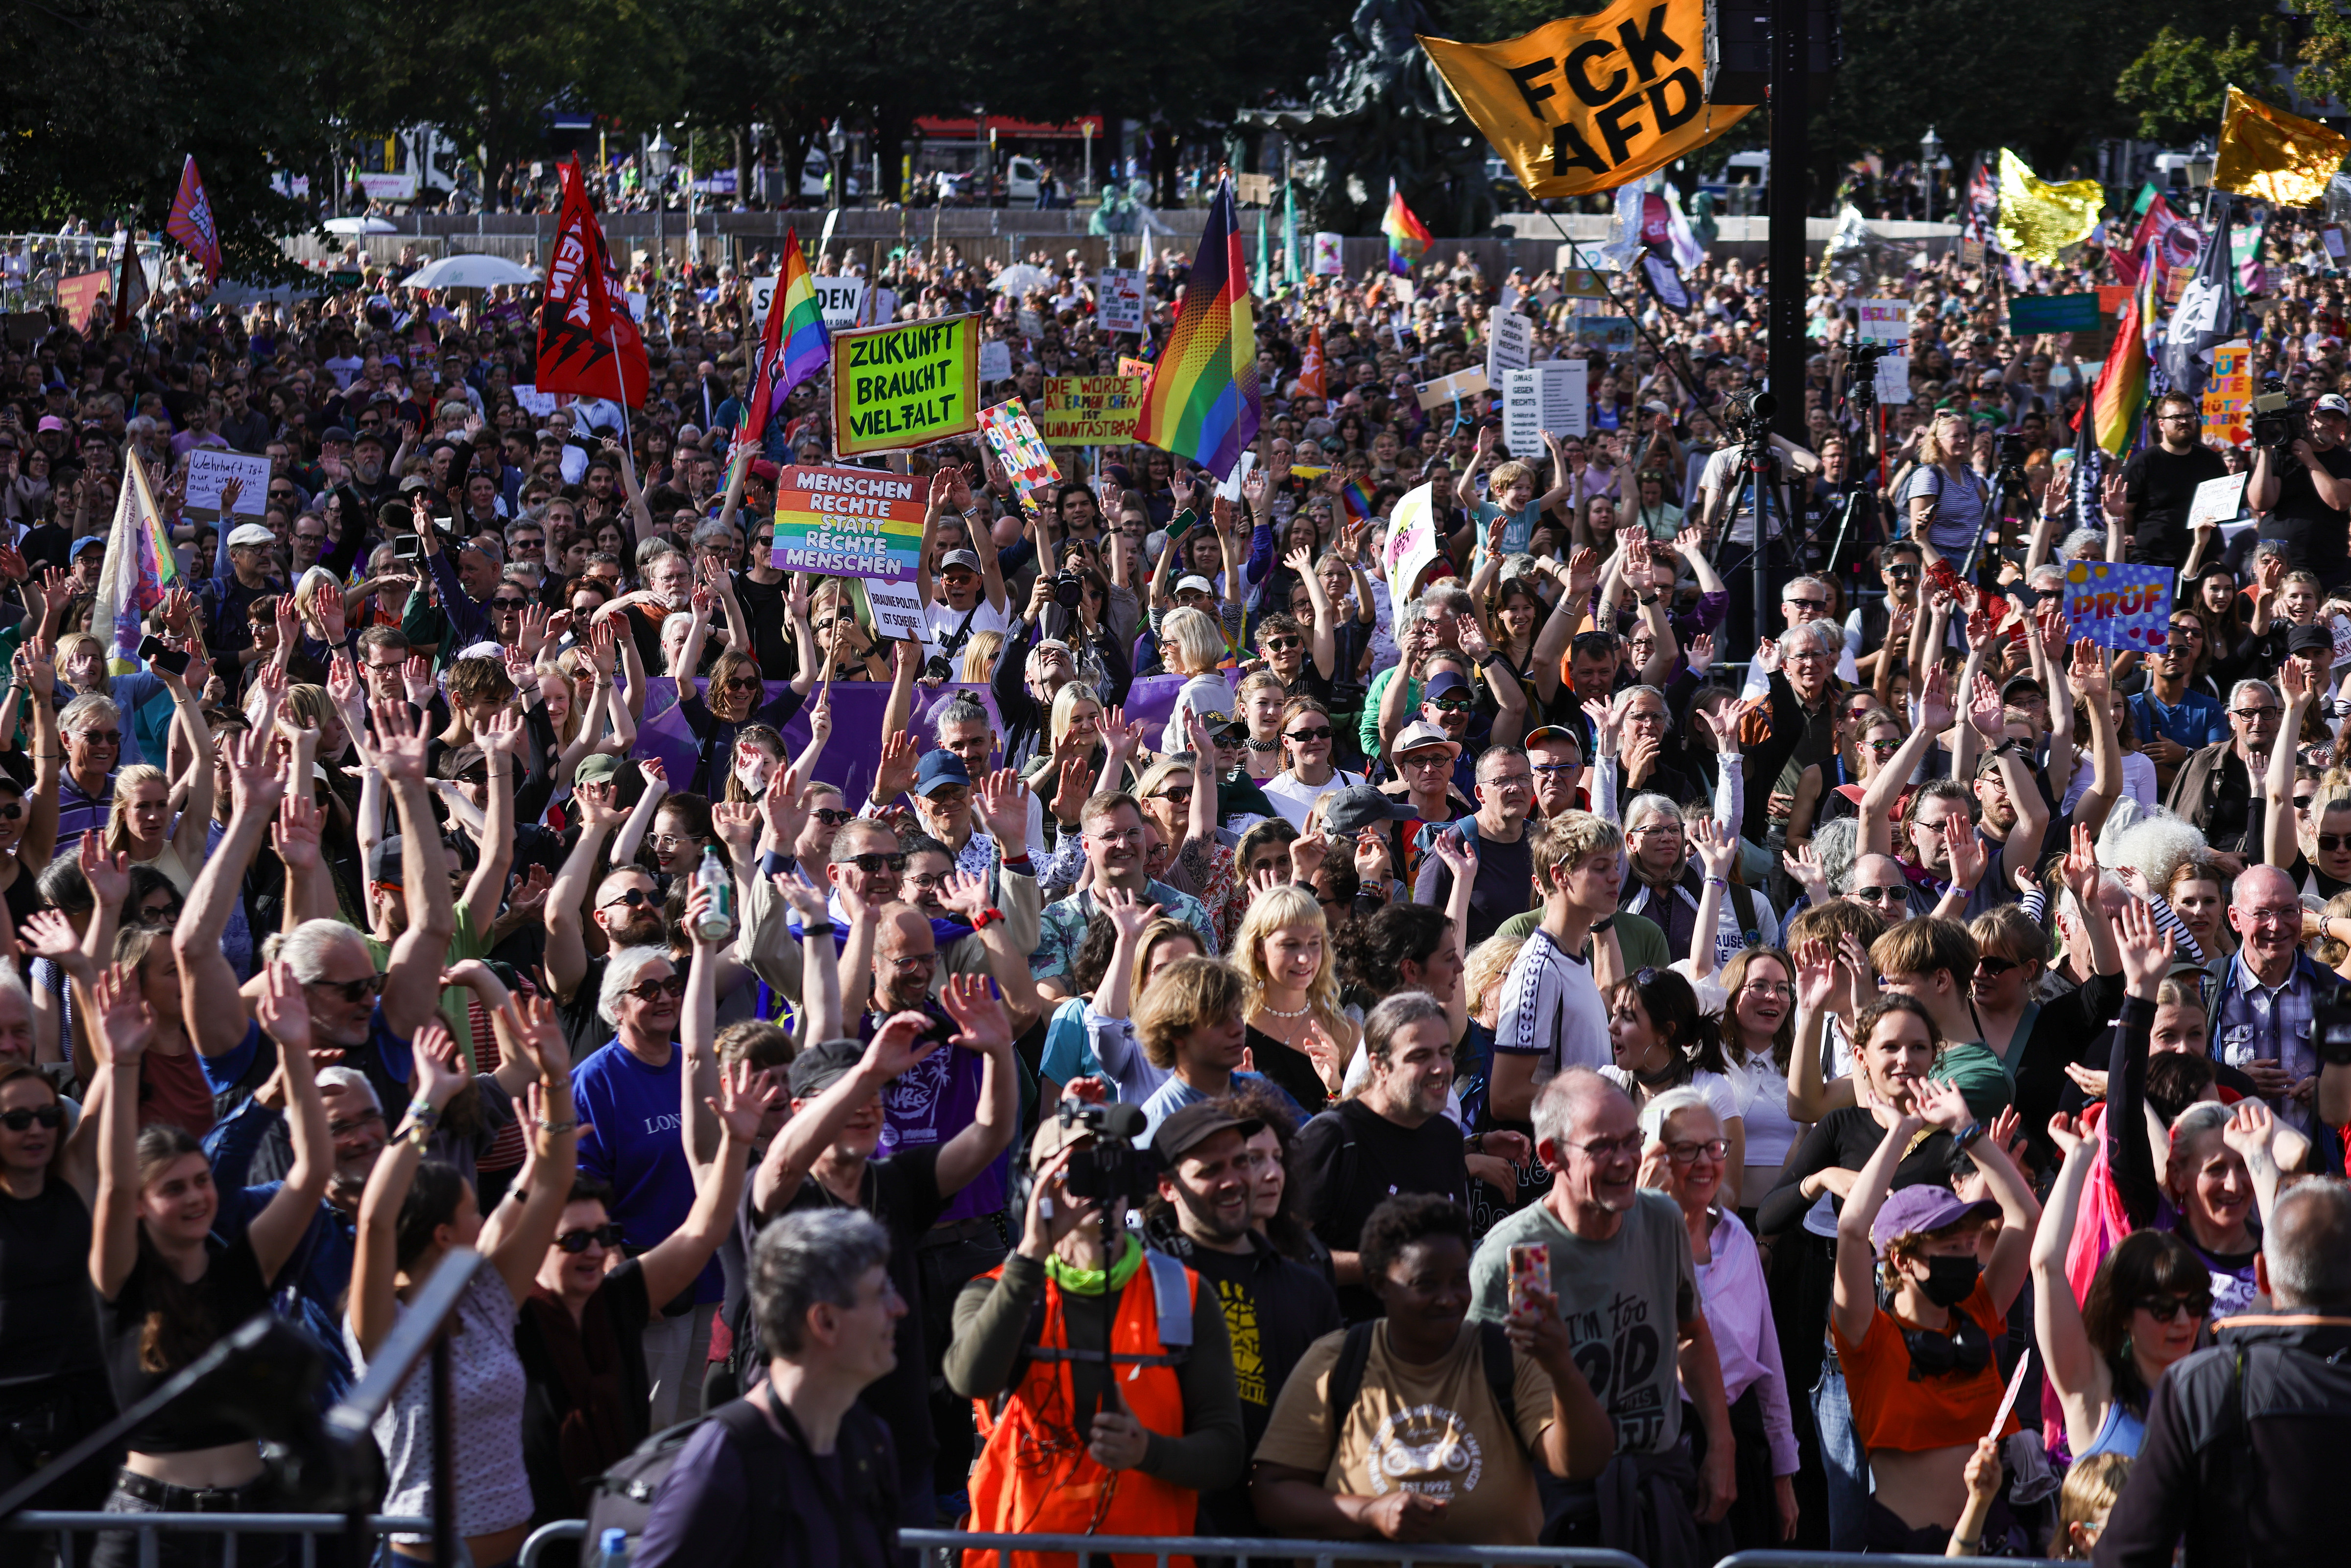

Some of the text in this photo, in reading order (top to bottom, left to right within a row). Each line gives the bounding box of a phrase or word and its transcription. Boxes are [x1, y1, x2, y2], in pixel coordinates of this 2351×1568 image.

[1506, 3, 1684, 120] FCK
[1553, 67, 1702, 176] AFD
[2231, 233, 2247, 248] PIE
[757, 288, 856, 310] SDEN
[1503, 318, 1522, 331] OMAS
[1861, 305, 1907, 322] BERLIN
[850, 320, 961, 367] ZUKUNFT
[1501, 329, 1523, 342] GEGEN
[1498, 339, 1524, 355] RECHTS
[2215, 354, 2248, 376] ÜF
[857, 359, 952, 405] BRAUCHT
[1045, 377, 1133, 394] DIE WÜRDE
[1512, 386, 1534, 394] GEGEN
[2207, 377, 2245, 393] UTE
[1511, 398, 1536, 406] RECHTS
[2202, 399, 2242, 412] HÜTZ
[850, 393, 956, 437] VIELFALT
[1082, 410, 1102, 420] IST
[2202, 413, 2241, 426] RGEN
[986, 415, 1036, 450] BLEIB
[1046, 419, 1136, 437] UNANTASTBAR
[193, 452, 263, 475] Wehrhaft ist
[999, 439, 1049, 477] BUNT
[796, 472, 912, 500] MENSCHEN
[810, 493, 892, 517] RECHTE
[819, 514, 885, 536] STATT
[806, 530, 888, 555] RECHTE
[786, 547, 902, 575] MENSCHEN
[871, 593, 921, 611] BRAUNE POLITIK
[2073, 584, 2164, 624] PRÜF
[882, 613, 892, 624] IST
[1716, 935, 1743, 949] AUSE
[644, 1113, 682, 1135] LON
[1607, 1291, 1649, 1341] too
[1565, 1310, 1603, 1348] I'M
[1573, 1324, 1659, 1413] OLD
